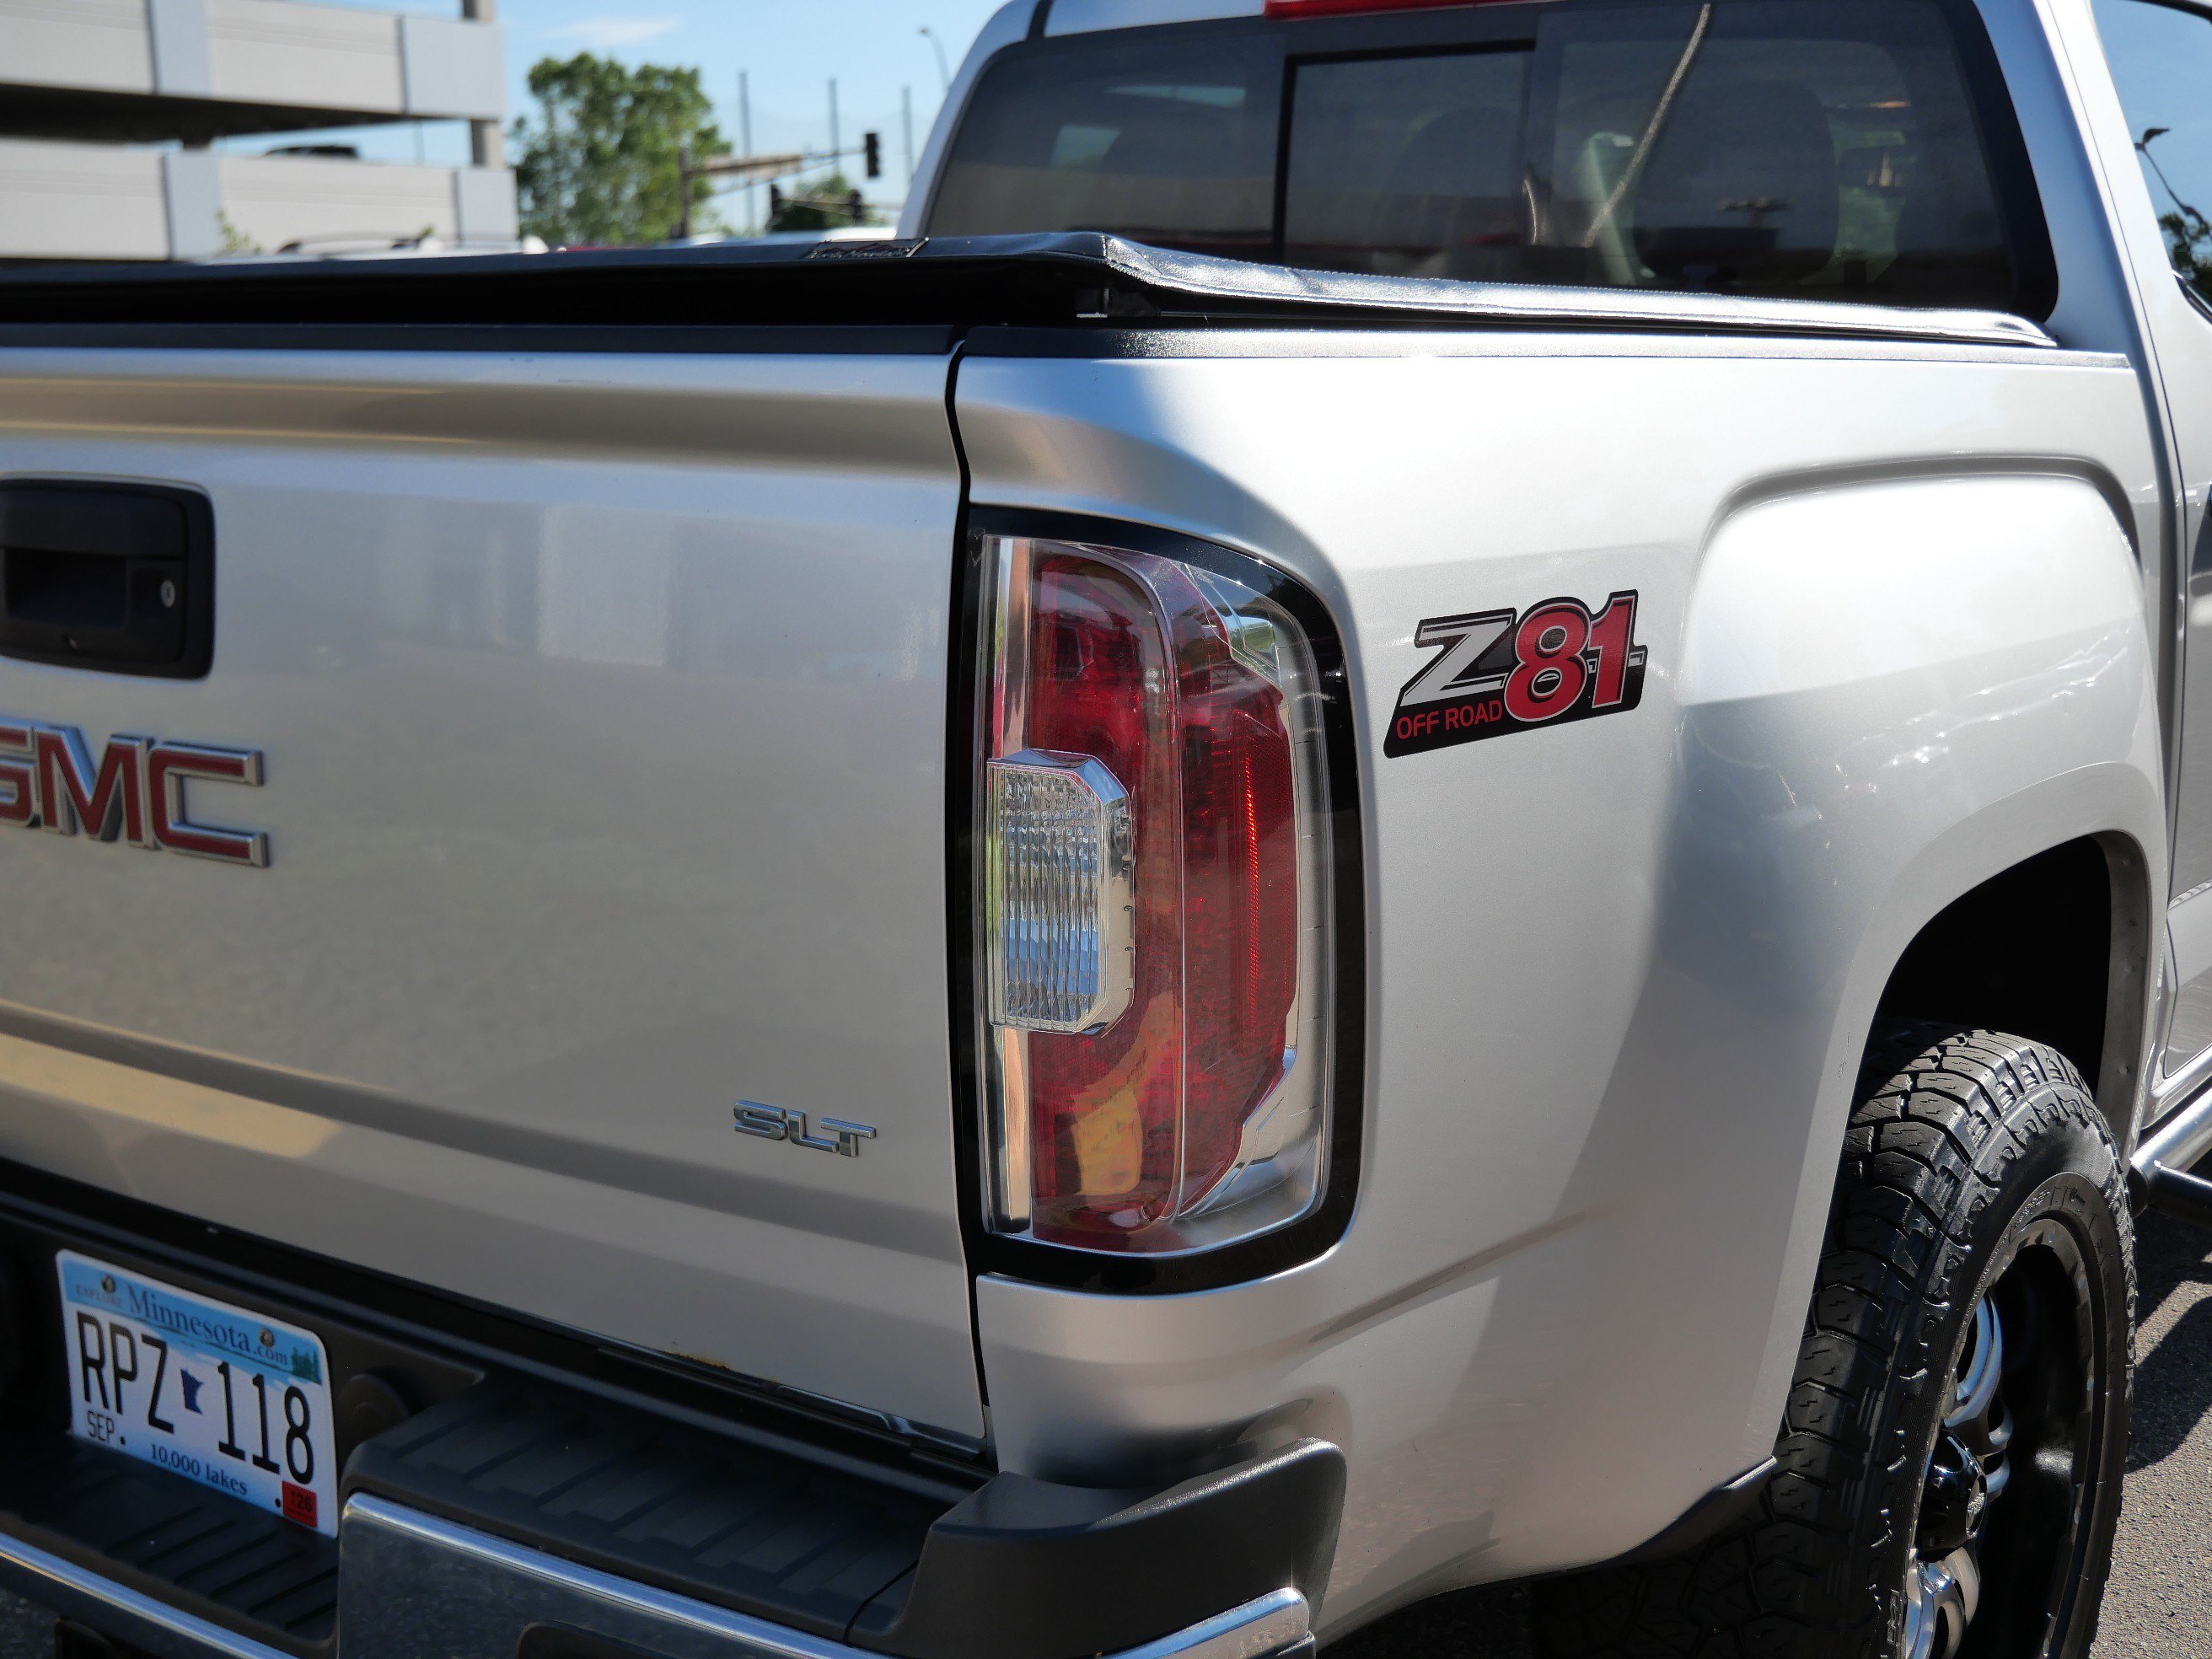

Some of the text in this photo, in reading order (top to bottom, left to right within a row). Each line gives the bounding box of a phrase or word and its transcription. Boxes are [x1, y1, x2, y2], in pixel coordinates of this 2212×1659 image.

[1399, 593, 1636, 722] Z81
[1396, 700, 1504, 739] OFF ROAD
[733, 1099, 876, 1157] SLT
[76, 1311, 314, 1485] RPZ 118
[86, 1409, 115, 1443] SEP
[150, 1442, 248, 1495] 10,000 lakes
